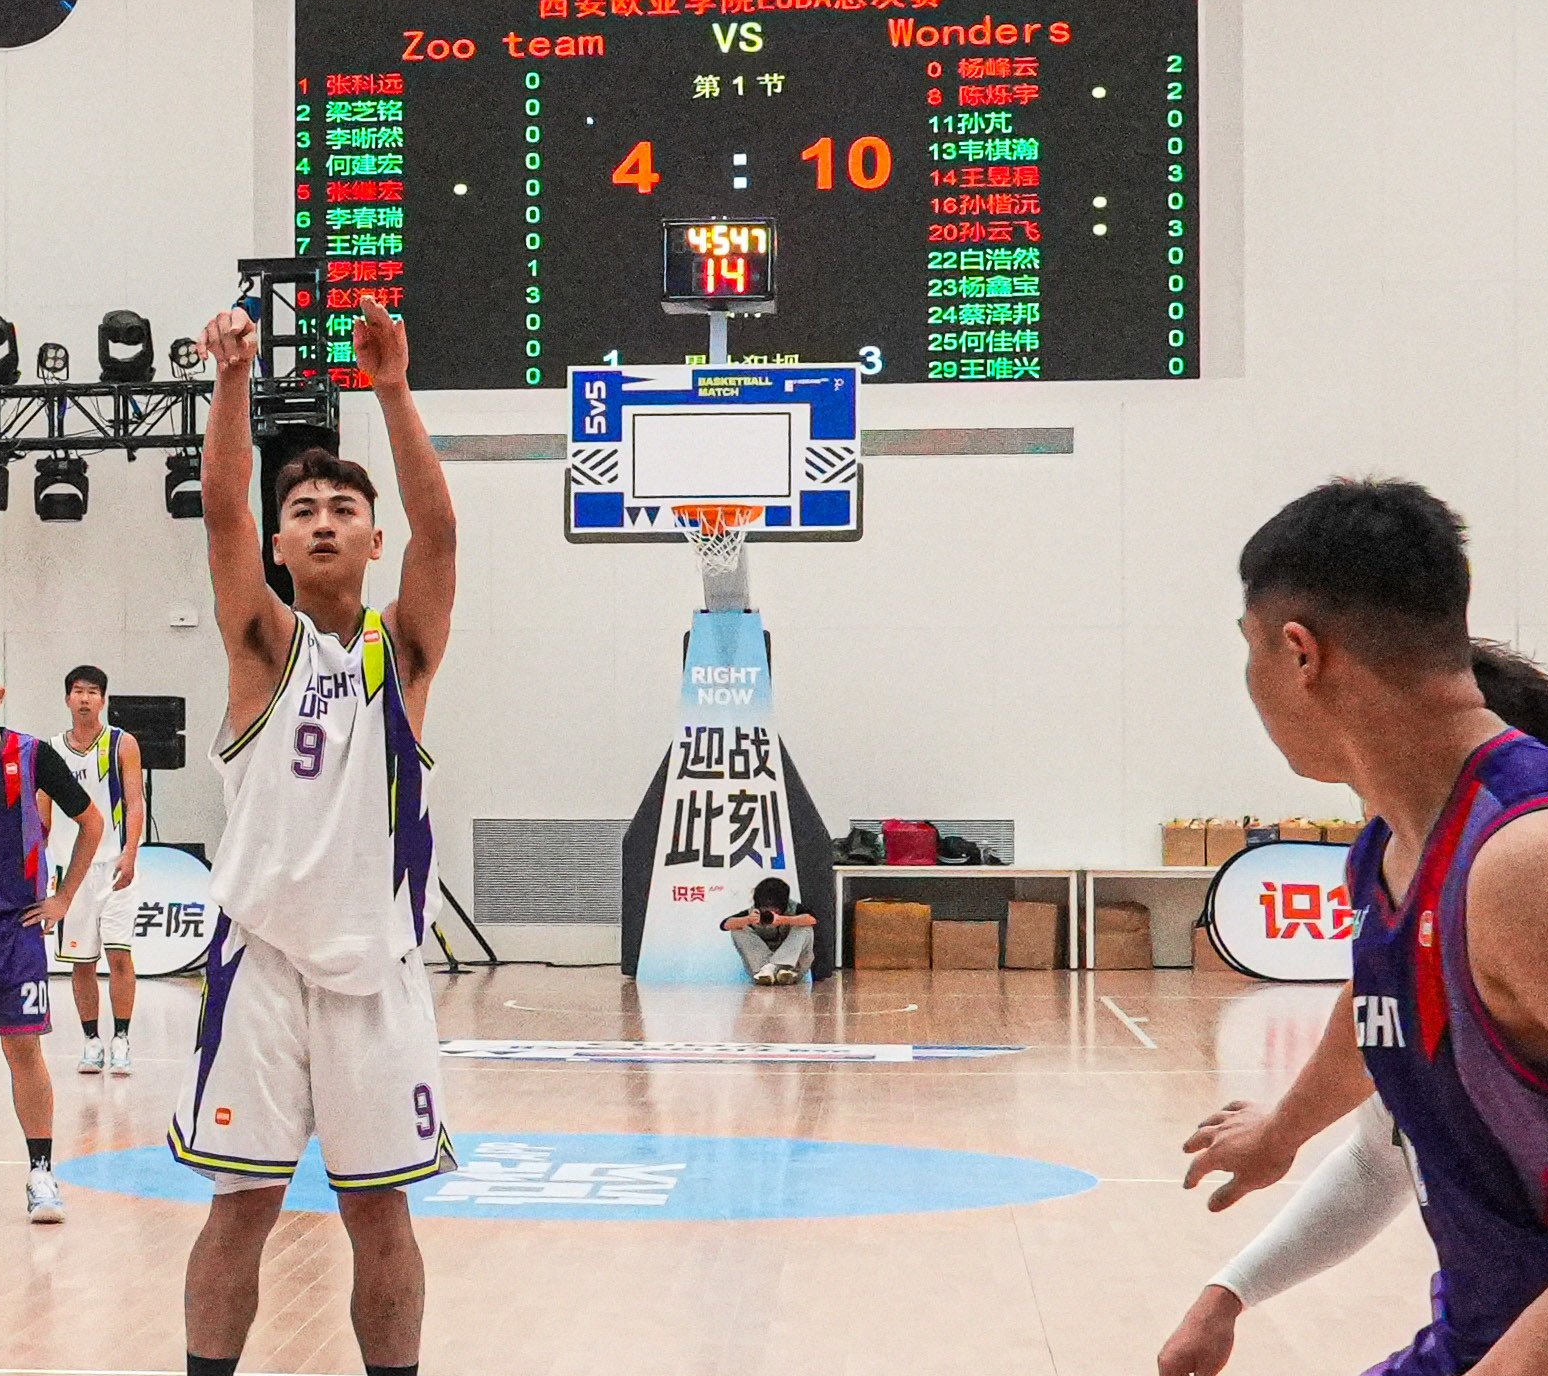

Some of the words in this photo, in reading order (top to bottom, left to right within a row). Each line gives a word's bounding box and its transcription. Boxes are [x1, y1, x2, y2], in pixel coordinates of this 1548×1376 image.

[712, 22, 763, 53] VS
[888, 18, 1071, 46] Wonders
[404, 32, 475, 60] Zoo
[503, 33, 604, 58] team
[928, 62, 942, 79] 0
[958, 56, 1040, 78] 杨峰云
[1167, 55, 1184, 73] 2
[295, 77, 312, 96] 1
[326, 73, 404, 95] 张科远
[525, 72, 541, 90] 0
[928, 89, 942, 106] 8
[1167, 83, 1184, 100] 2
[295, 104, 312, 122] 2
[326, 100, 404, 121] 梁芝铭
[525, 99, 541, 116] 0
[928, 116, 957, 133] 11
[1167, 110, 1184, 128] 0
[295, 130, 312, 149] 3
[525, 126, 541, 143] 0
[928, 143, 957, 160] 13
[1167, 138, 1184, 155] 0
[295, 157, 312, 175] 4
[326, 153, 404, 175] 何建宏
[525, 153, 541, 170] 0
[612, 141, 661, 193] 4
[802, 137, 892, 190] 10
[928, 170, 957, 187] 14
[1167, 165, 1184, 183] 3
[295, 183, 312, 202] 5
[326, 180, 404, 201] 张继宏
[525, 180, 541, 197] 0
[928, 198, 957, 215] 16
[1167, 193, 1184, 210] 0
[295, 210, 312, 228] 6
[326, 207, 404, 228] 李春瑞
[525, 207, 541, 224] 0
[928, 225, 957, 242] 20
[958, 220, 1040, 242] 孙云飞
[1167, 220, 1184, 238] 3
[295, 237, 312, 255] 7
[326, 233, 404, 255] 王浩伟
[525, 233, 541, 251] 0
[525, 260, 541, 278] 1
[928, 252, 957, 269] 22
[958, 247, 1040, 269] 白浩然
[1167, 248, 1184, 265] 0
[707, 258, 745, 293] 14
[928, 279, 957, 296] 23
[958, 275, 1040, 297] 杨鑫宝
[1167, 275, 1184, 293] 0
[295, 290, 312, 308] 9
[525, 287, 541, 305] 3
[525, 314, 541, 332] 0
[928, 307, 957, 324] 24
[958, 302, 1040, 324] 蔡泽邦
[1167, 303, 1184, 320] 0
[525, 341, 541, 359] 0
[928, 334, 957, 351] 25
[958, 330, 1040, 352] 何佳伟
[1167, 330, 1184, 348] 0
[858, 346, 883, 374] 3
[928, 361, 957, 378] 29
[958, 357, 1040, 379] 王唯兴
[1167, 358, 1184, 375] 0
[525, 368, 541, 386] 0
[698, 377, 773, 386] BASKETBALL
[698, 387, 740, 397] MATCH
[585, 380, 607, 434] 5v5
[691, 666, 762, 684] RIGHT
[299, 694, 329, 720] UP
[697, 687, 754, 706] NOW
[291, 722, 326, 780] 9
[676, 726, 777, 781] 迎战
[664, 788, 786, 870] 此刻
[20, 981, 47, 1015] 20
[414, 1082, 437, 1140] 9
